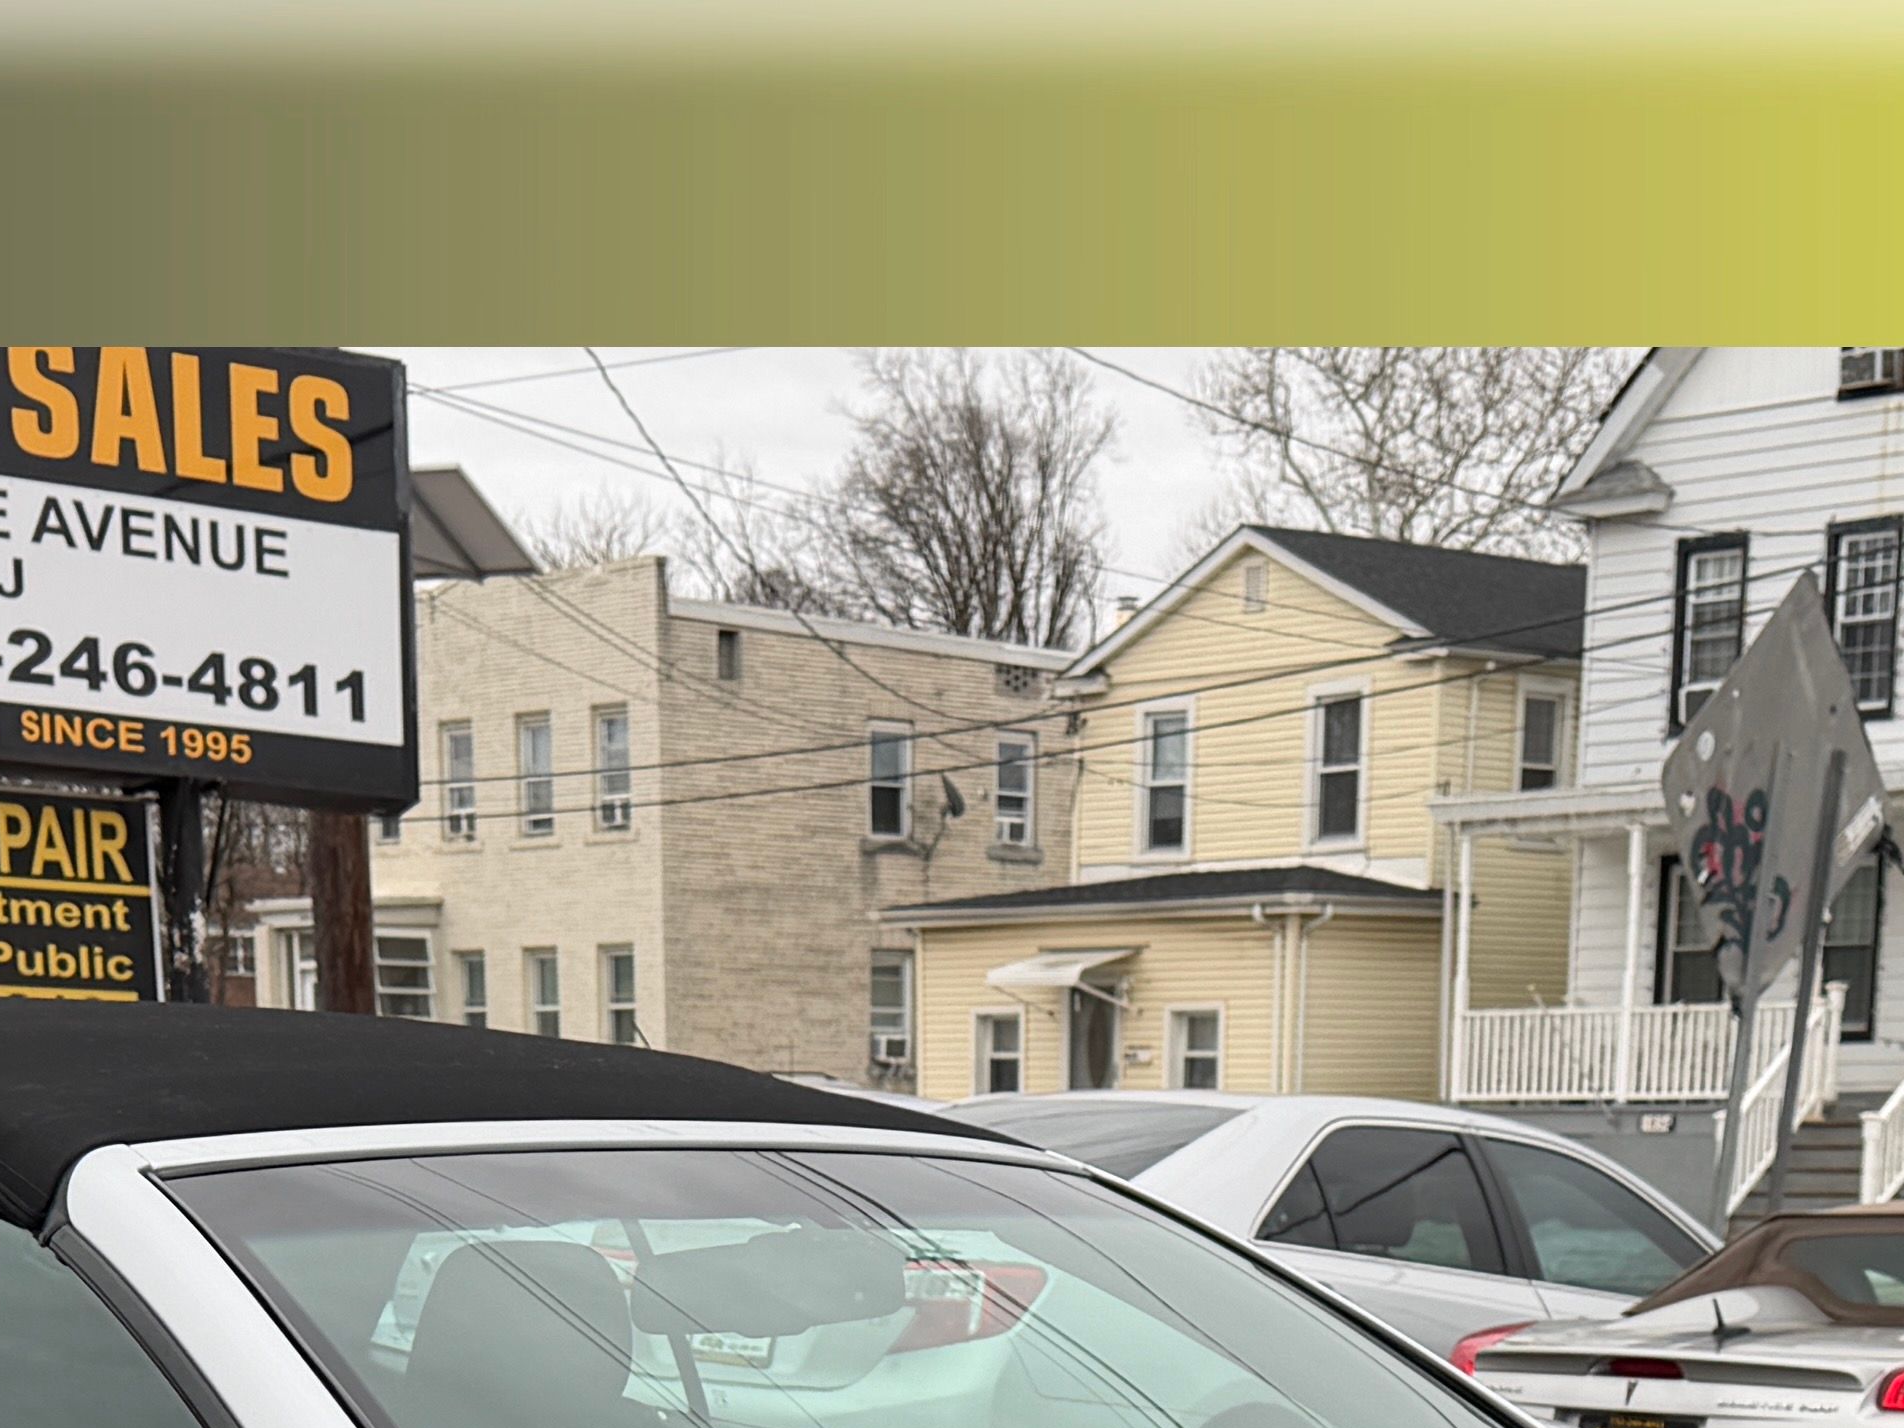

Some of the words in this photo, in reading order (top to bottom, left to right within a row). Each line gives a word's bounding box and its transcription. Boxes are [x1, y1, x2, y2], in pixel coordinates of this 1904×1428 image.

[10, 346, 354, 503] SALES
[31, 497, 290, 578] AVENUE
[20, 709, 147, 754] SINCE
[160, 726, 254, 764] 1995
